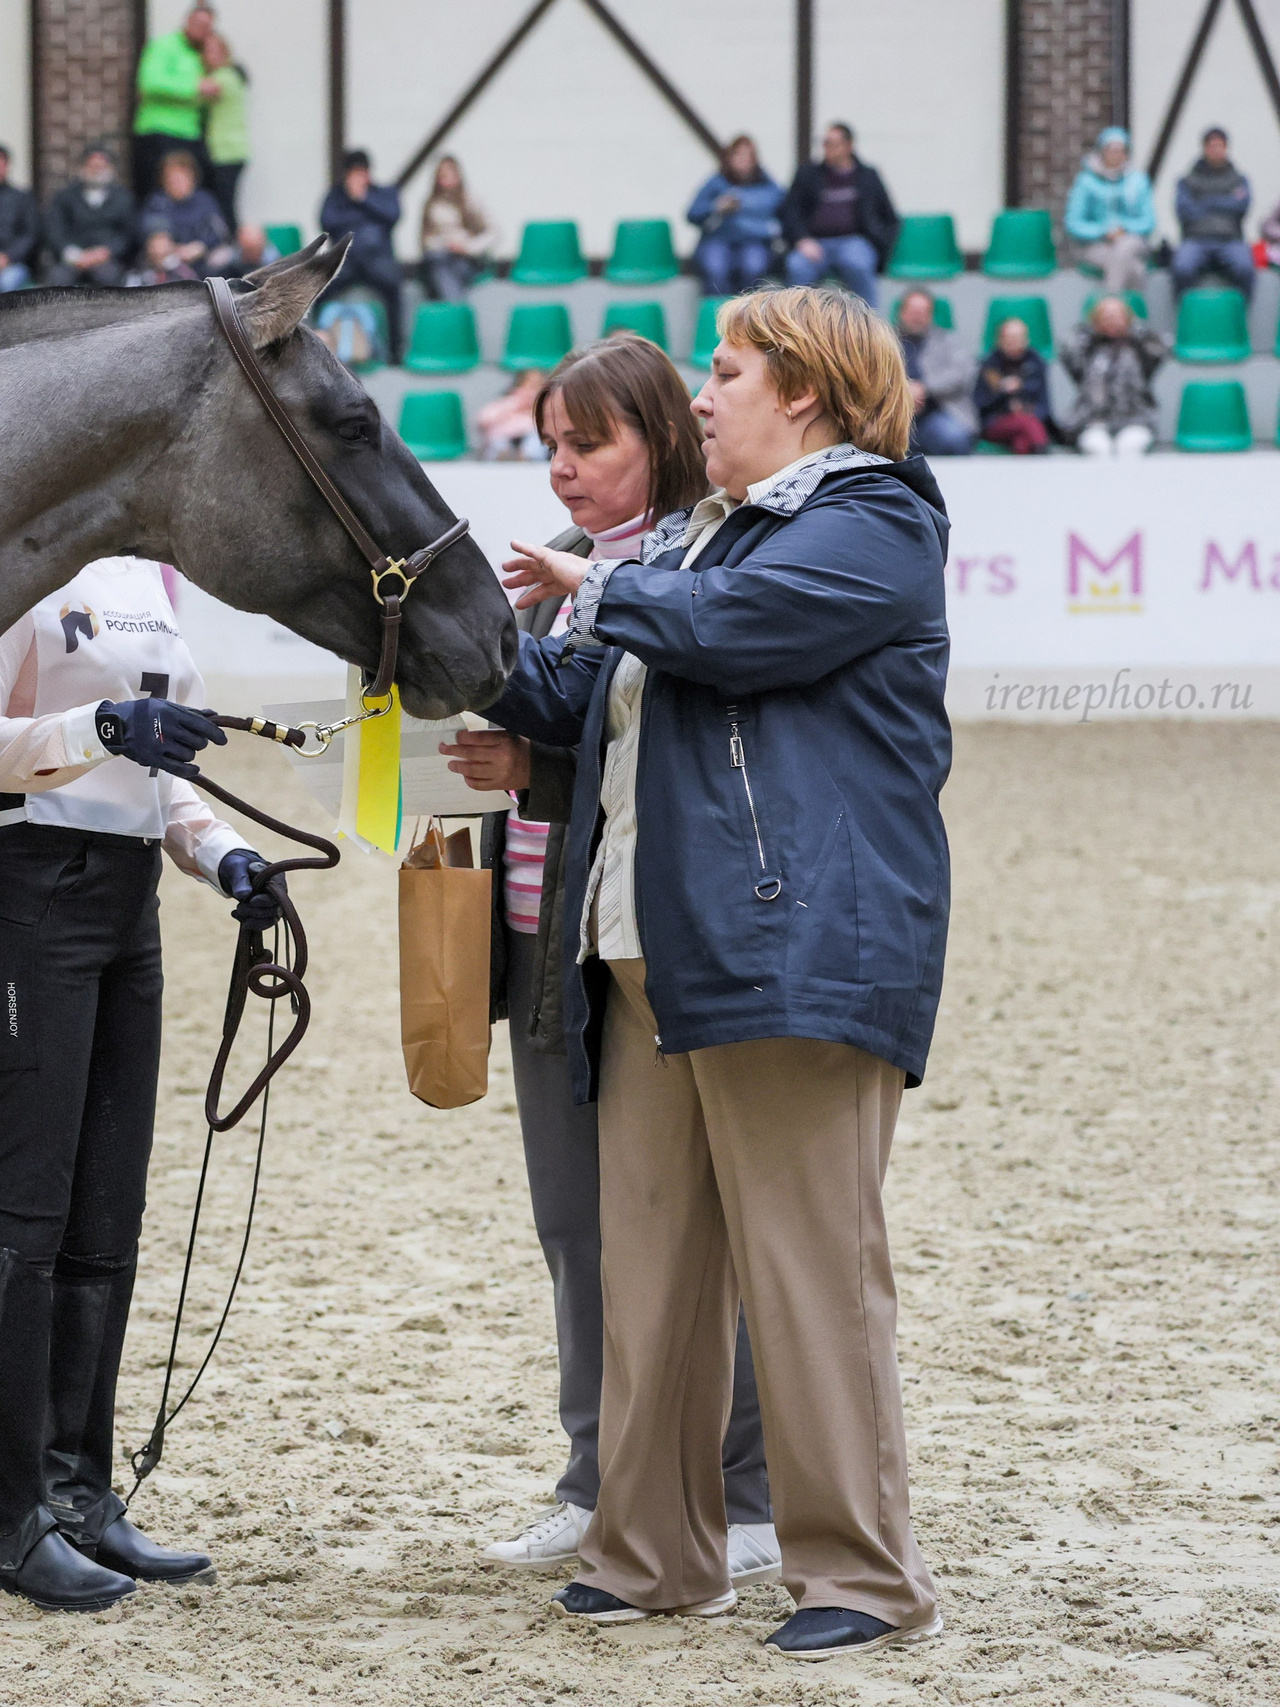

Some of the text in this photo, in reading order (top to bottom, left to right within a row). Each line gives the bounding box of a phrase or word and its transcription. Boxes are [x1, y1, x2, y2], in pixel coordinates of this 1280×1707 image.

[946, 555, 1018, 595] rs
[103, 610, 152, 620] АССОЦИАЦИЯ
[6, 982, 19, 1038] HORSENJOY
